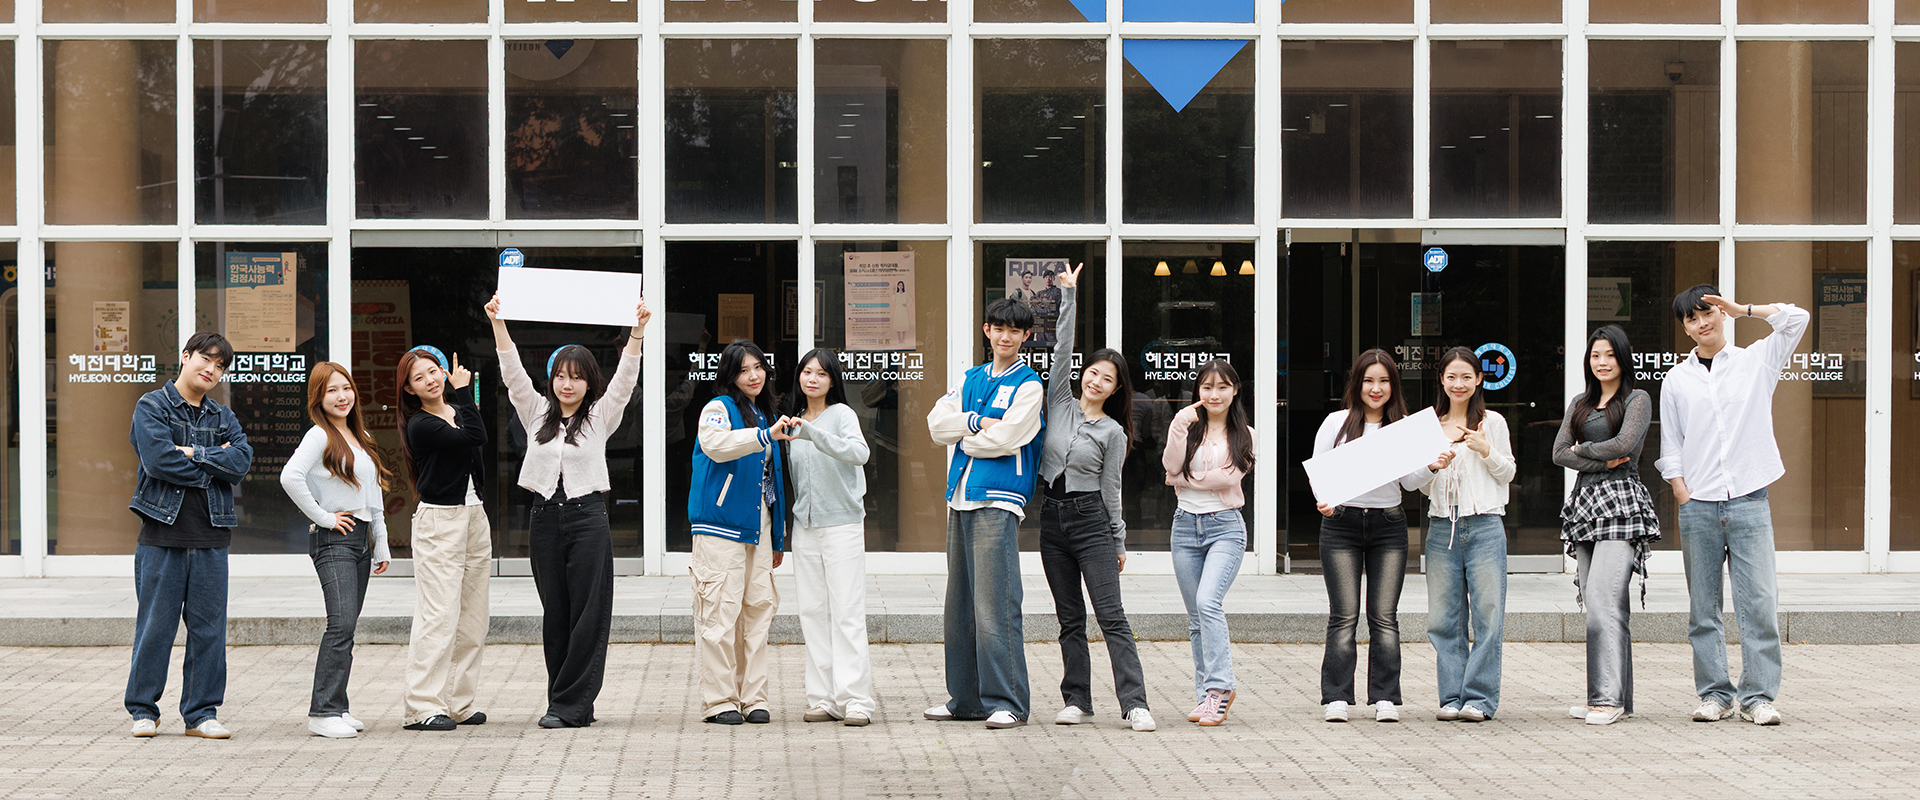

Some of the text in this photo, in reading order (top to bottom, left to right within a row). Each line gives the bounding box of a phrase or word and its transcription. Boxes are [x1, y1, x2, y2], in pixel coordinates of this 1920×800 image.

[504, 255, 521, 265] ADT
[1428, 255, 1444, 264] ADT
[230, 264, 275, 274] 한국사능력
[1009, 261, 1066, 277] ROKA
[230, 274, 266, 284] 검정시험
[1823, 285, 1862, 294] 한국사능력
[1823, 293, 1854, 302] 검정시험
[366, 317, 404, 325] GOPIZZA
[69, 354, 156, 372] 혜전대학교
[838, 352, 924, 369] 혜전대학교
[69, 373, 156, 383] HYEJEON COLLEGE
[262, 373, 306, 383] COLLEGE
[881, 371, 924, 381] COLLEGE
[1145, 372, 1187, 381] HYEJEON
[1803, 372, 1844, 381] COLLEGE
[276, 385, 301, 393] 10,000
[275, 398, 301, 406] 25,000
[275, 410, 301, 418] 40,000
[275, 423, 301, 431] 50,000
[276, 436, 300, 444] 70,000
